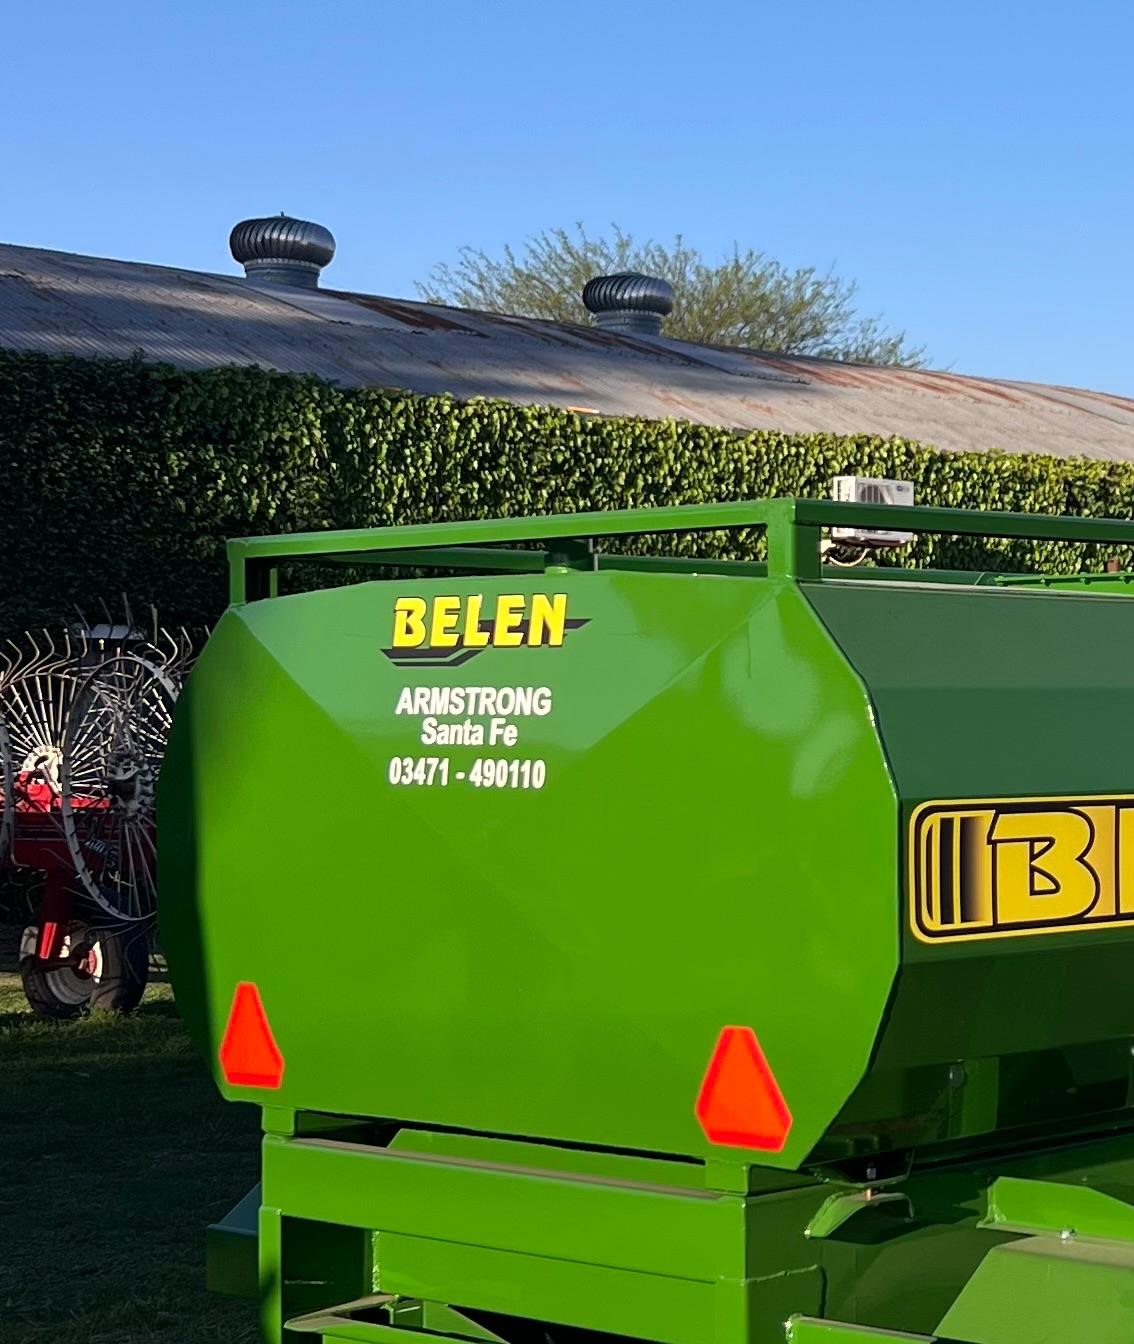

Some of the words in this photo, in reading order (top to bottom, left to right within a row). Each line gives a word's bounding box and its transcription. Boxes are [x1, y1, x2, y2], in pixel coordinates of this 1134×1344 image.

[392, 593, 567, 648] BELEN
[395, 687, 552, 716] ARMSTRONG
[421, 717, 484, 746] Santa
[489, 718, 518, 746] Fe
[388, 757, 449, 786] 03471
[469, 759, 546, 789] 490110
